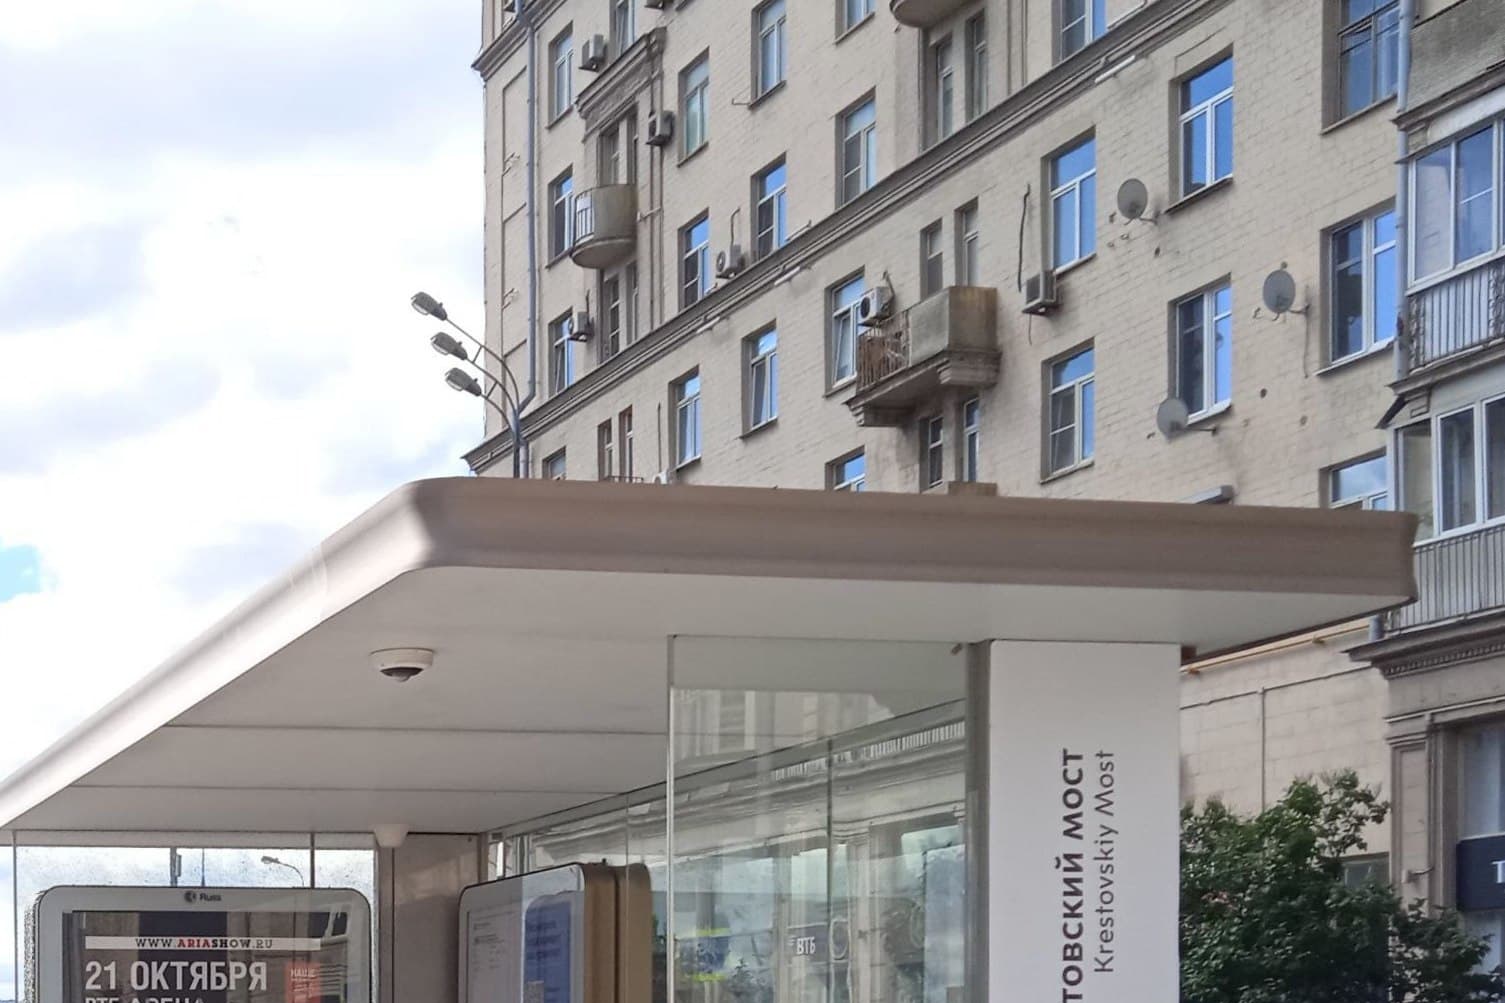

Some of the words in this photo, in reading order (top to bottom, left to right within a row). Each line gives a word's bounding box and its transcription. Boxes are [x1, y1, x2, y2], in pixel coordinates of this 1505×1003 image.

[1062, 748, 1084, 840] мост
[1093, 750, 1114, 816] Most
[1093, 823, 1119, 973] Krestovskiy
[135, 938, 273, 949] WWW.ARIASHOW.RU
[796, 937, 816, 955] ВТБ
[85, 960, 117, 990] 21
[129, 961, 267, 991] ОКТЯБРЯ
